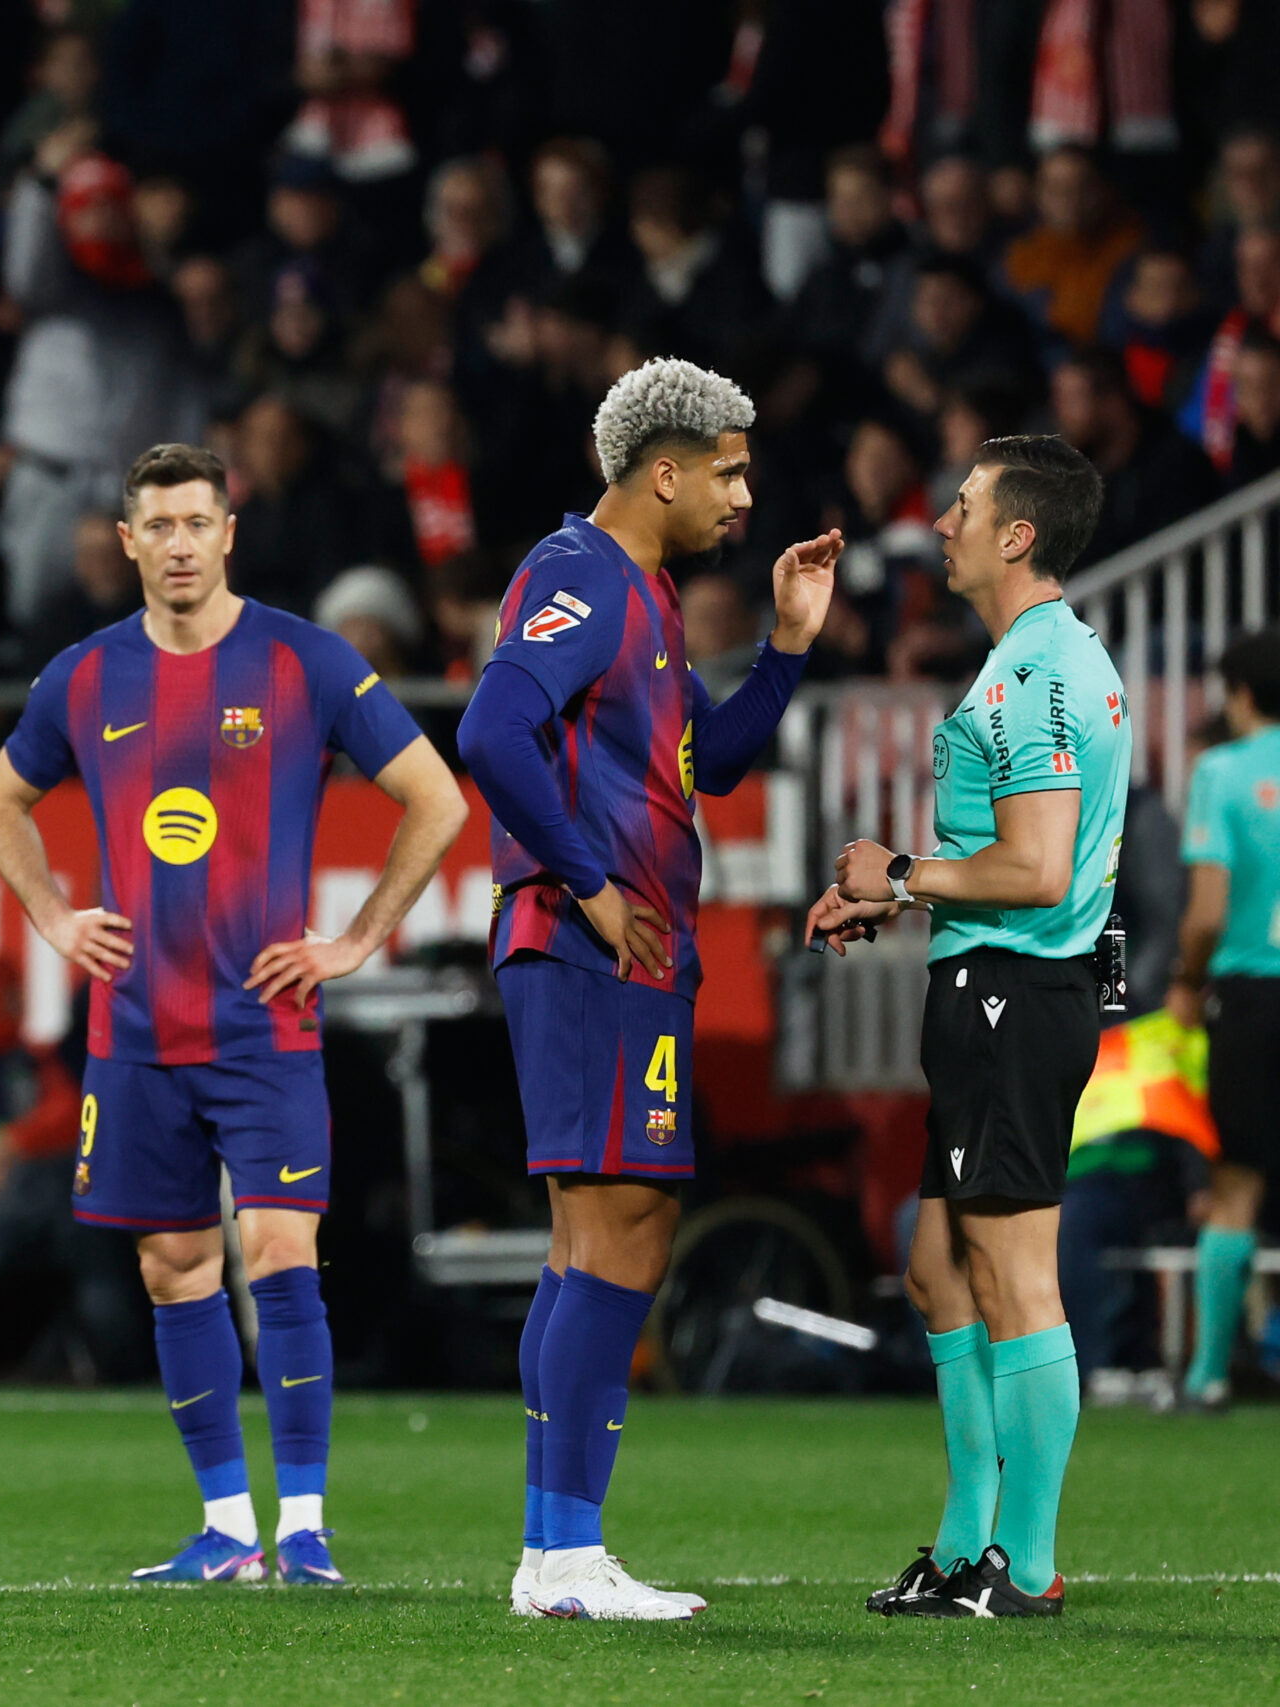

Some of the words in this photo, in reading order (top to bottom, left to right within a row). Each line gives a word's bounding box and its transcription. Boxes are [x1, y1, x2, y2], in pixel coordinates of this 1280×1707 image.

[989, 708, 1014, 782] WÜRTH
[1050, 681, 1066, 751] WÜRTH
[644, 1034, 678, 1103] 4
[81, 1093, 98, 1158] 9
